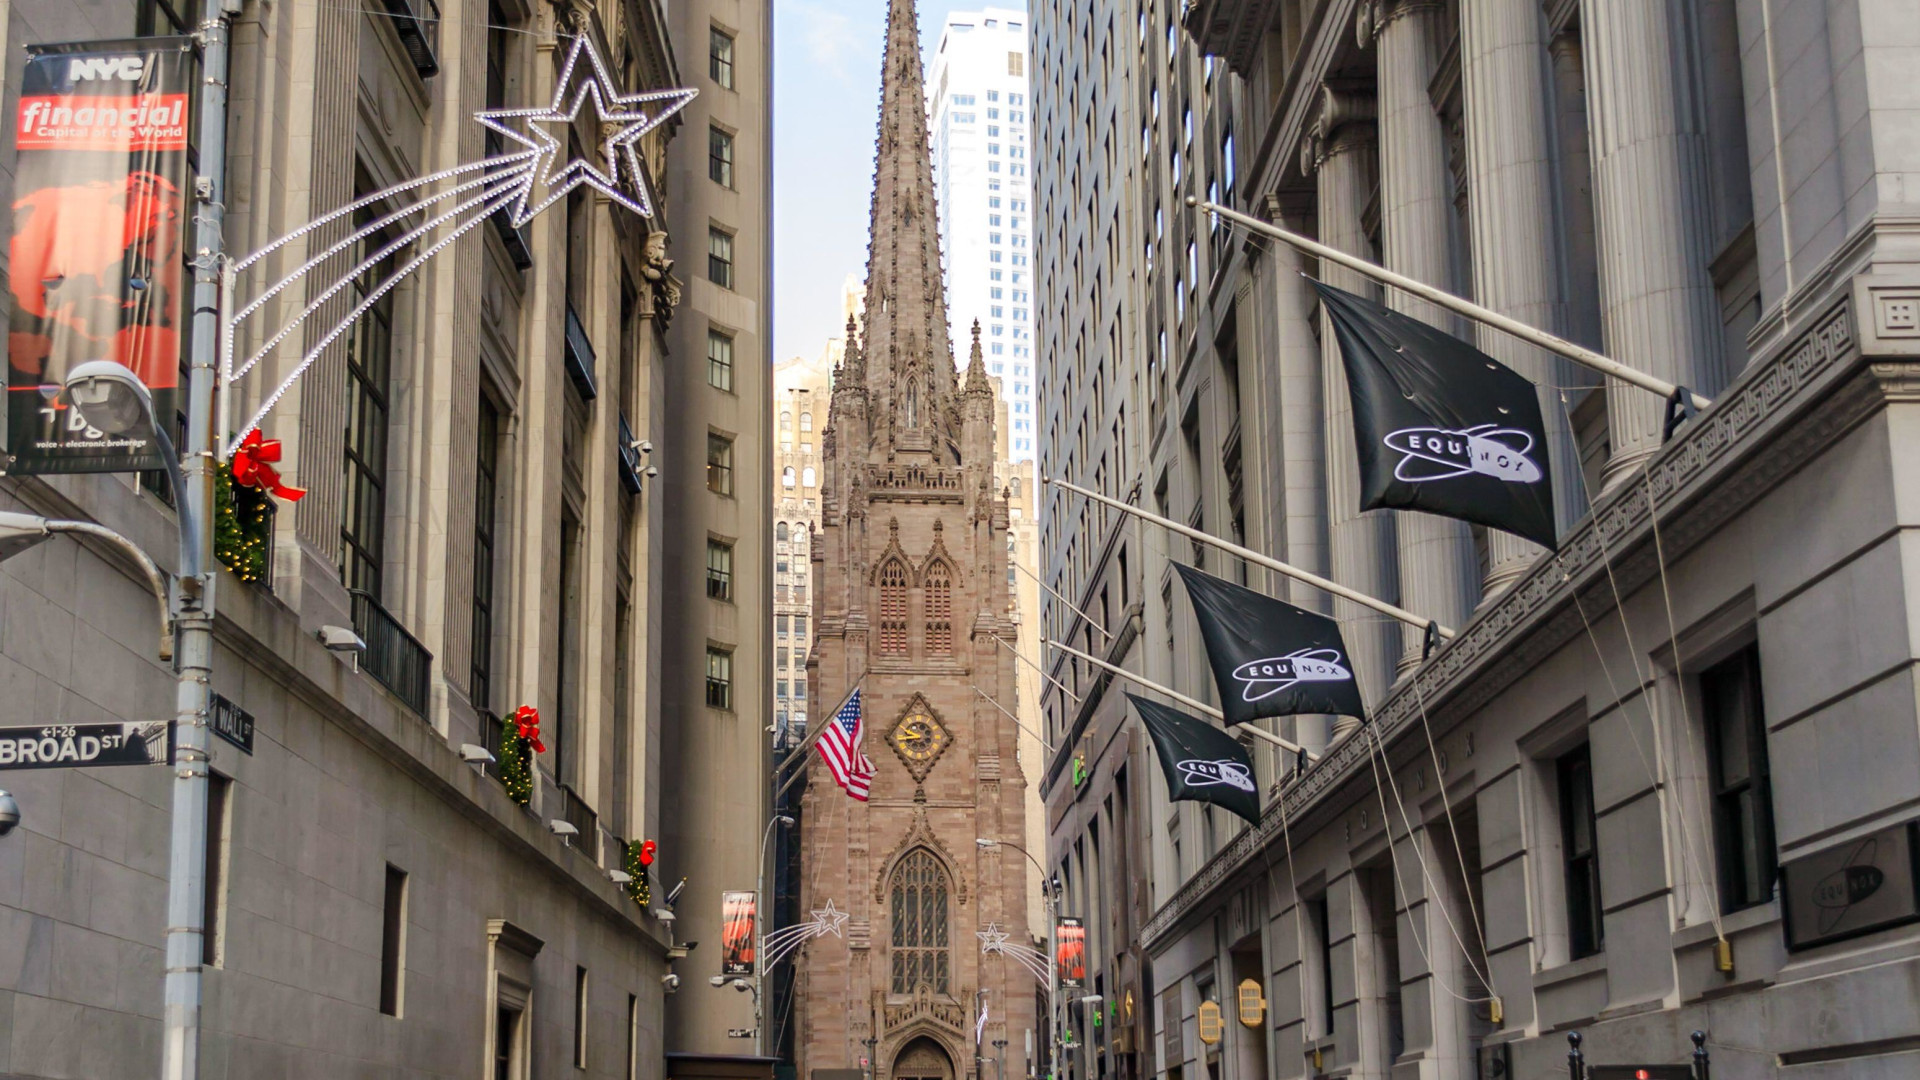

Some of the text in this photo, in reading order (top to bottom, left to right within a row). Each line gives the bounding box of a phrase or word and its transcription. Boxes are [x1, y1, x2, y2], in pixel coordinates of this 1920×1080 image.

[70, 58, 143, 80] NYC
[24, 101, 182, 132] financial
[37, 126, 183, 138] Capital of the World
[65, 440, 106, 448] electronic
[106, 439, 147, 449] brokerage
[1408, 435, 1524, 472] EQUINOX
[1248, 664, 1339, 676] EQUINOX
[51, 726, 77, 738] 1-26
[219, 706, 245, 743] WALL
[0, 735, 100, 763] BROAD
[102, 735, 122, 749] ST
